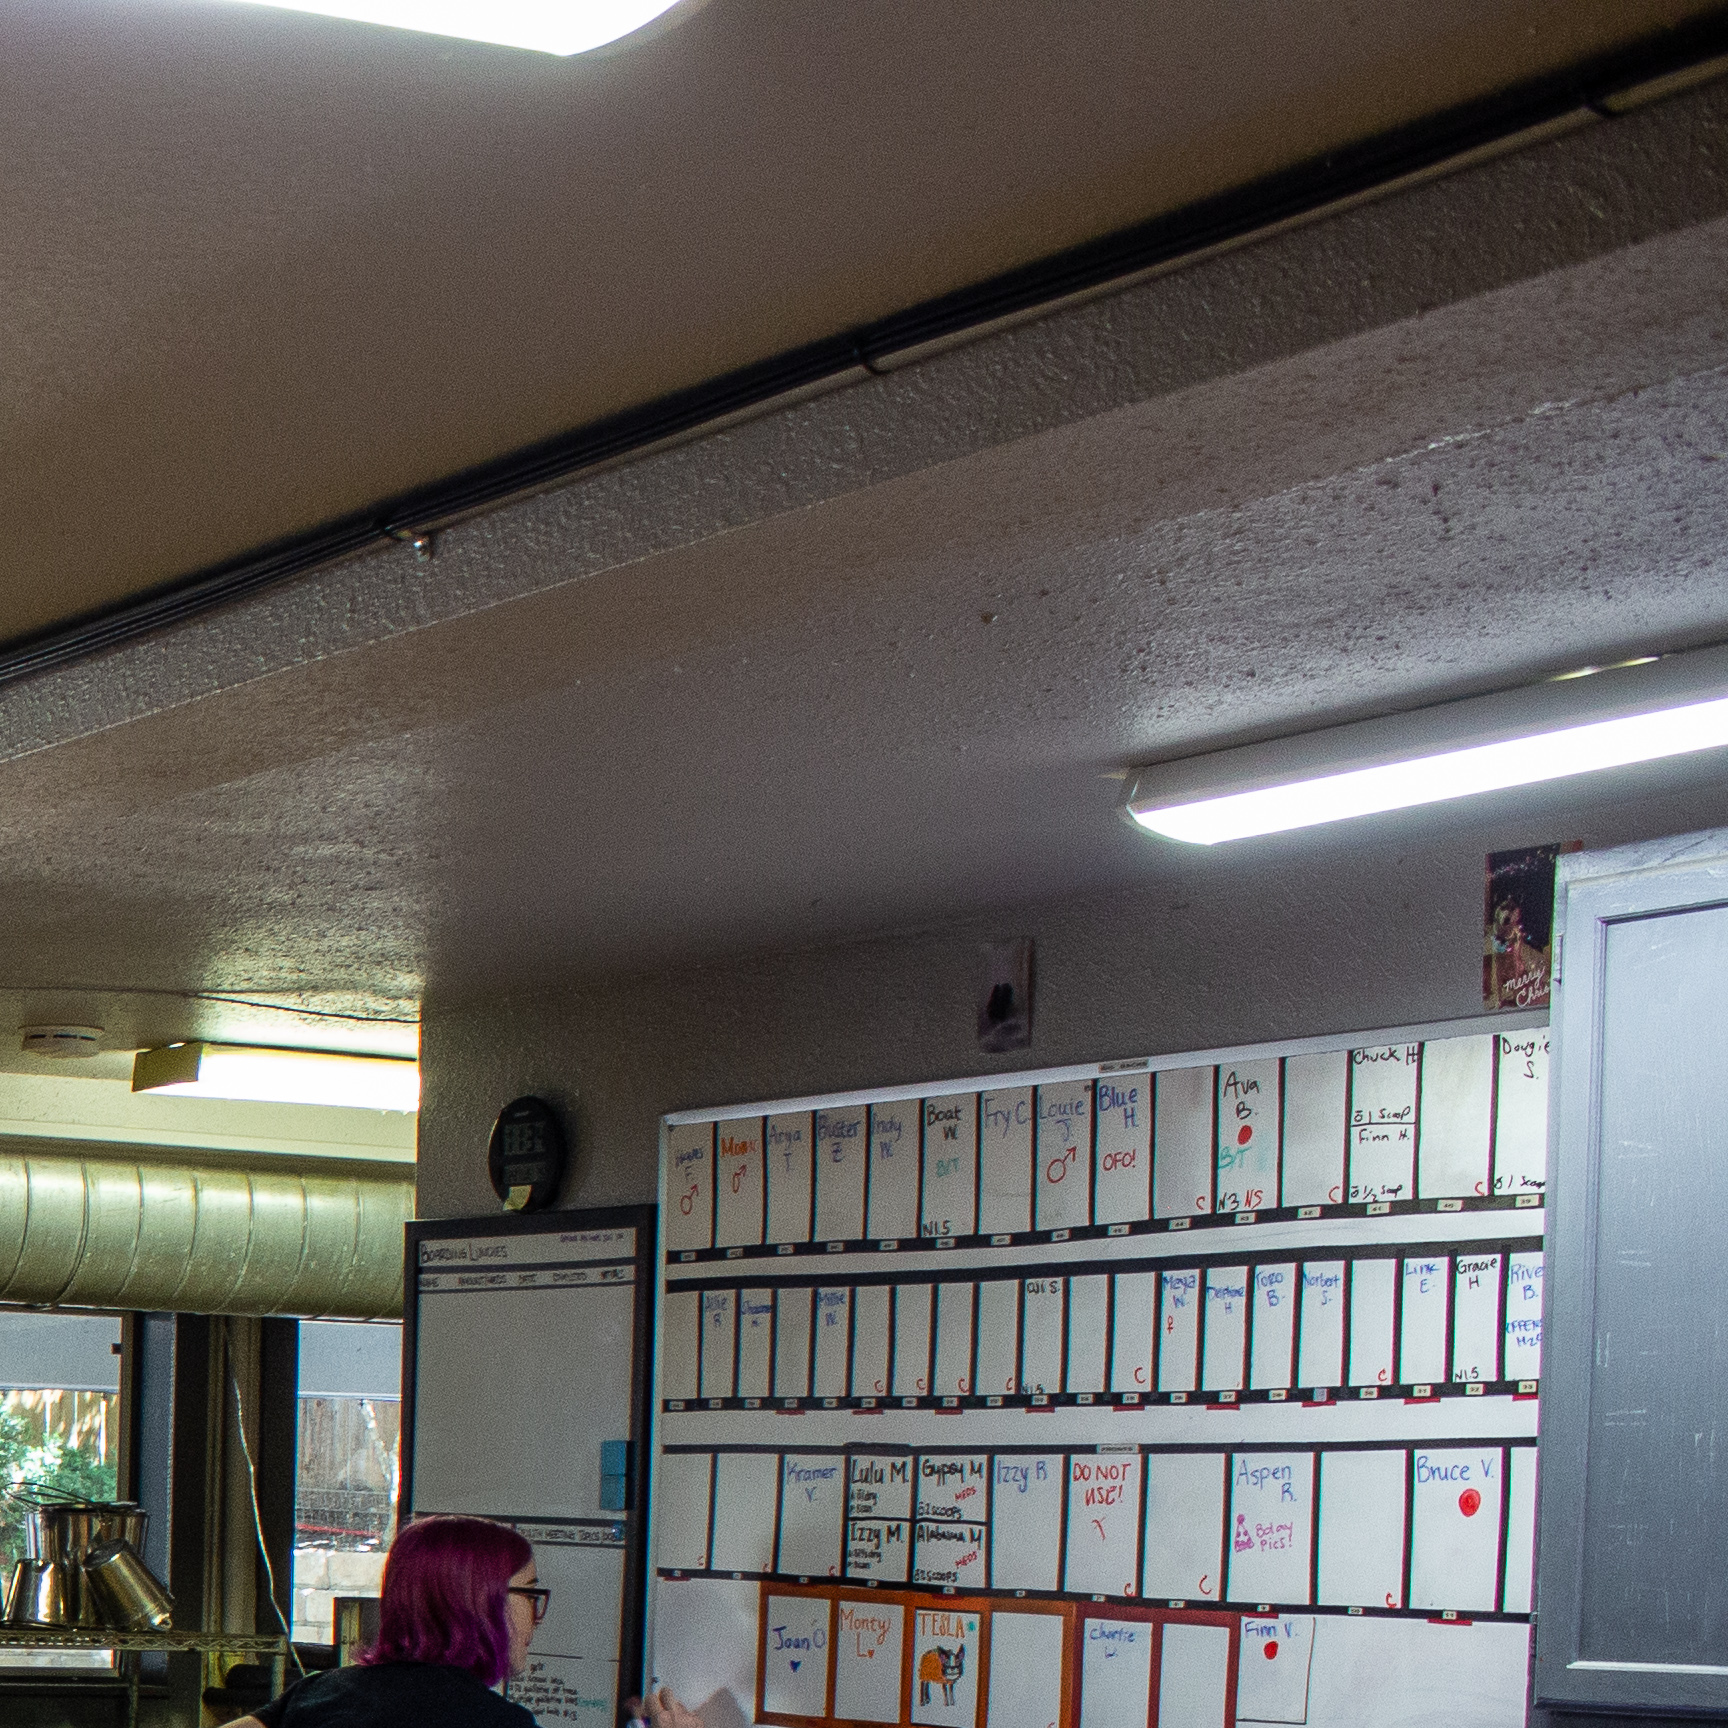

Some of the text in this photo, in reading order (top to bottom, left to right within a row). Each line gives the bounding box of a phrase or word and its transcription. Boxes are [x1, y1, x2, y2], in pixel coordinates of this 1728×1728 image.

[1516, 986, 1550, 1007] Chris
[1353, 1047, 1400, 1068] Chuck
[1223, 1071, 1260, 1099] Ava
[1039, 1096, 1084, 1120] Louie
[1099, 1085, 1138, 1112] Blue
[926, 1105, 962, 1127] Boat
[1124, 1107, 1139, 1128] H
[1456, 1257, 1497, 1273] Gracie
[1510, 1264, 1543, 1284] Rive
[1469, 1277, 1479, 1289] H
[787, 1460, 837, 1485] Kramer
[852, 1459, 883, 1485] Lulu
[922, 1459, 964, 1486] Gypsy
[997, 1462, 1029, 1493] Izzy
[1073, 1463, 1131, 1482] DO NOT
[1236, 1459, 1292, 1489] Aspen
[1417, 1456, 1470, 1483] Bruce
[1085, 1485, 1124, 1506] USE!
[850, 1525, 880, 1550] Izzy
[840, 1608, 890, 1645] Monty
[919, 1612, 965, 1639] TESLA
[1245, 1621, 1276, 1638] Finn
[773, 1626, 809, 1650] Joan
